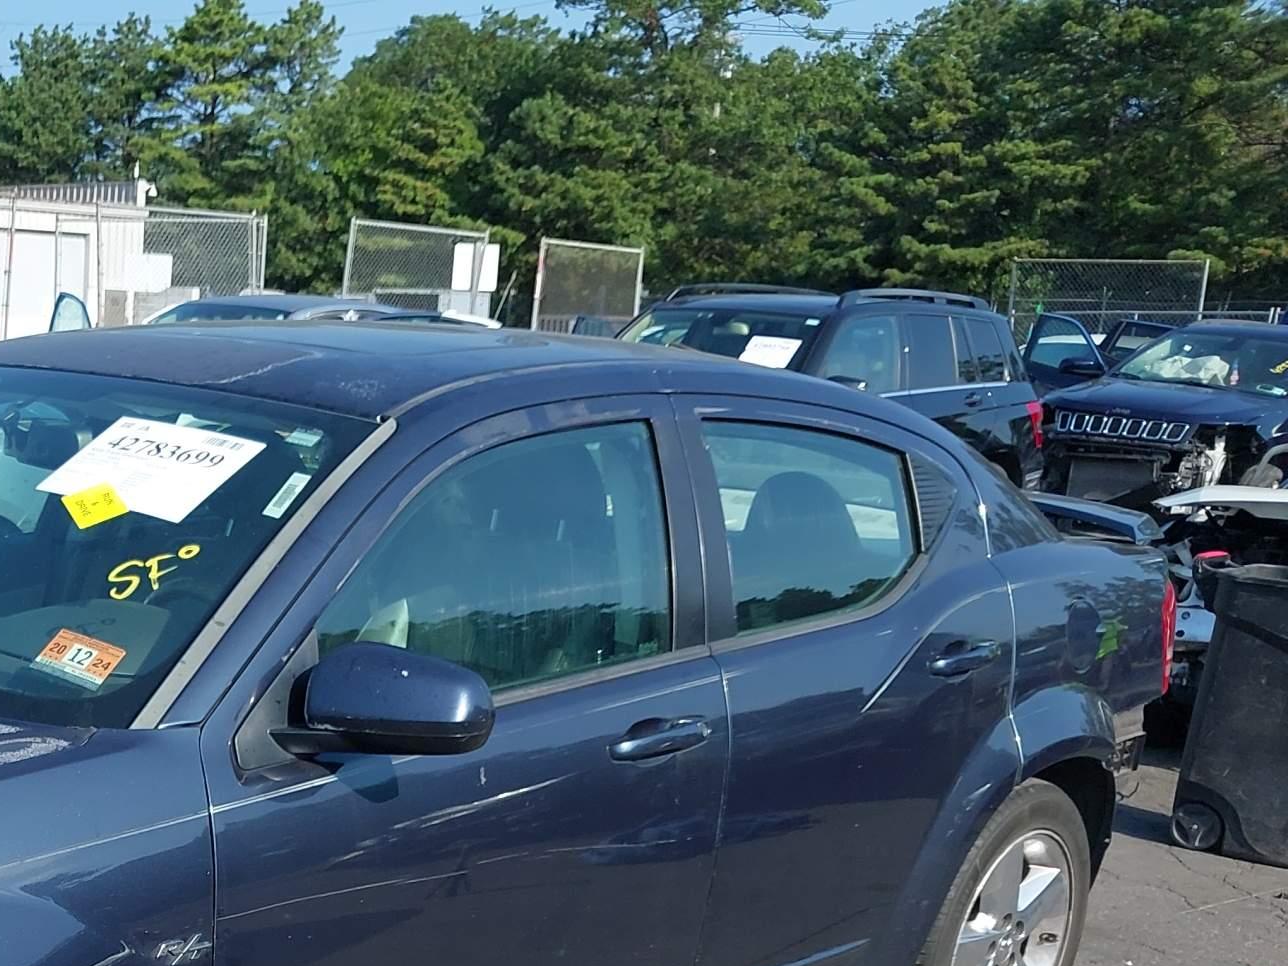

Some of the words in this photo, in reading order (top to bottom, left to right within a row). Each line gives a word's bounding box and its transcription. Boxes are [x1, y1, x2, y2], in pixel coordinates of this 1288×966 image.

[108, 435, 226, 468] 42783699
[48, 642, 68, 655] 20
[68, 647, 93, 666] 12
[92, 658, 112, 671] 24
[155, 933, 212, 966] R/T
